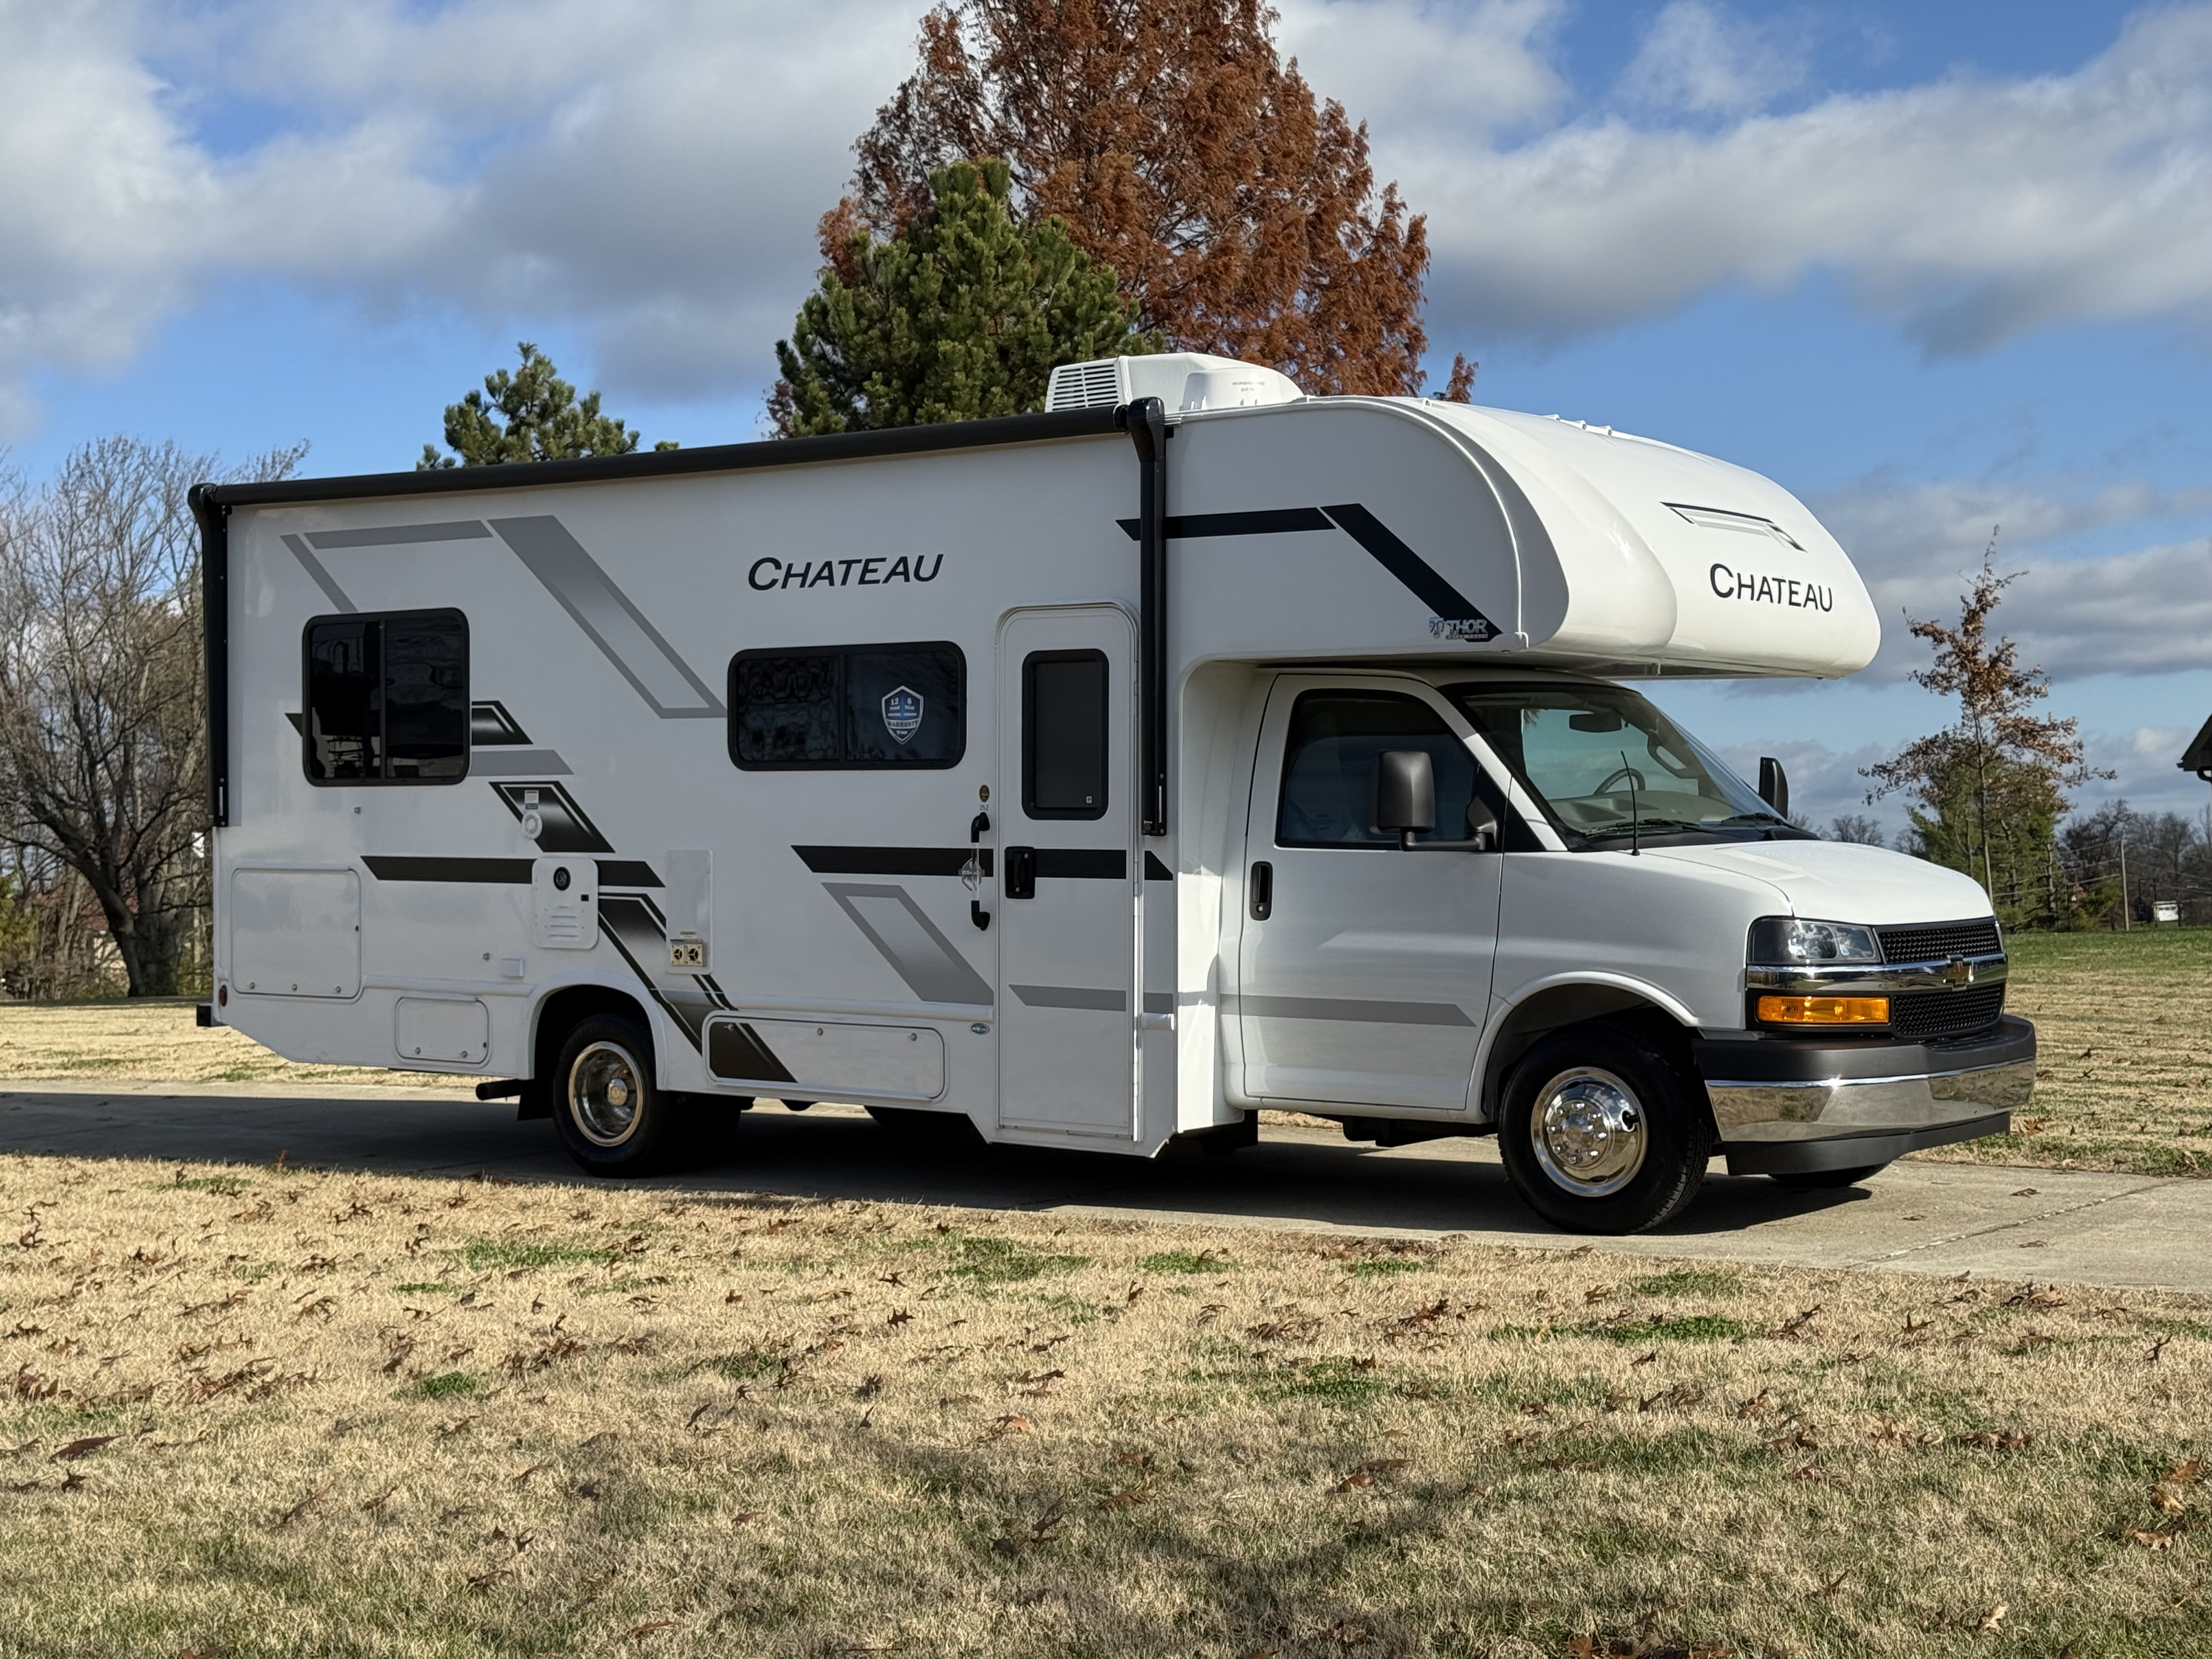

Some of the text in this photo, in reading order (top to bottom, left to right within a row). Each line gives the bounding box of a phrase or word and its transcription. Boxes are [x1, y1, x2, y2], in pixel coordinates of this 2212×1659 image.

[748, 554, 944, 591] CHATEAU
[1709, 563, 1833, 613] CHATEAU
[1446, 619, 1488, 635] THOR
